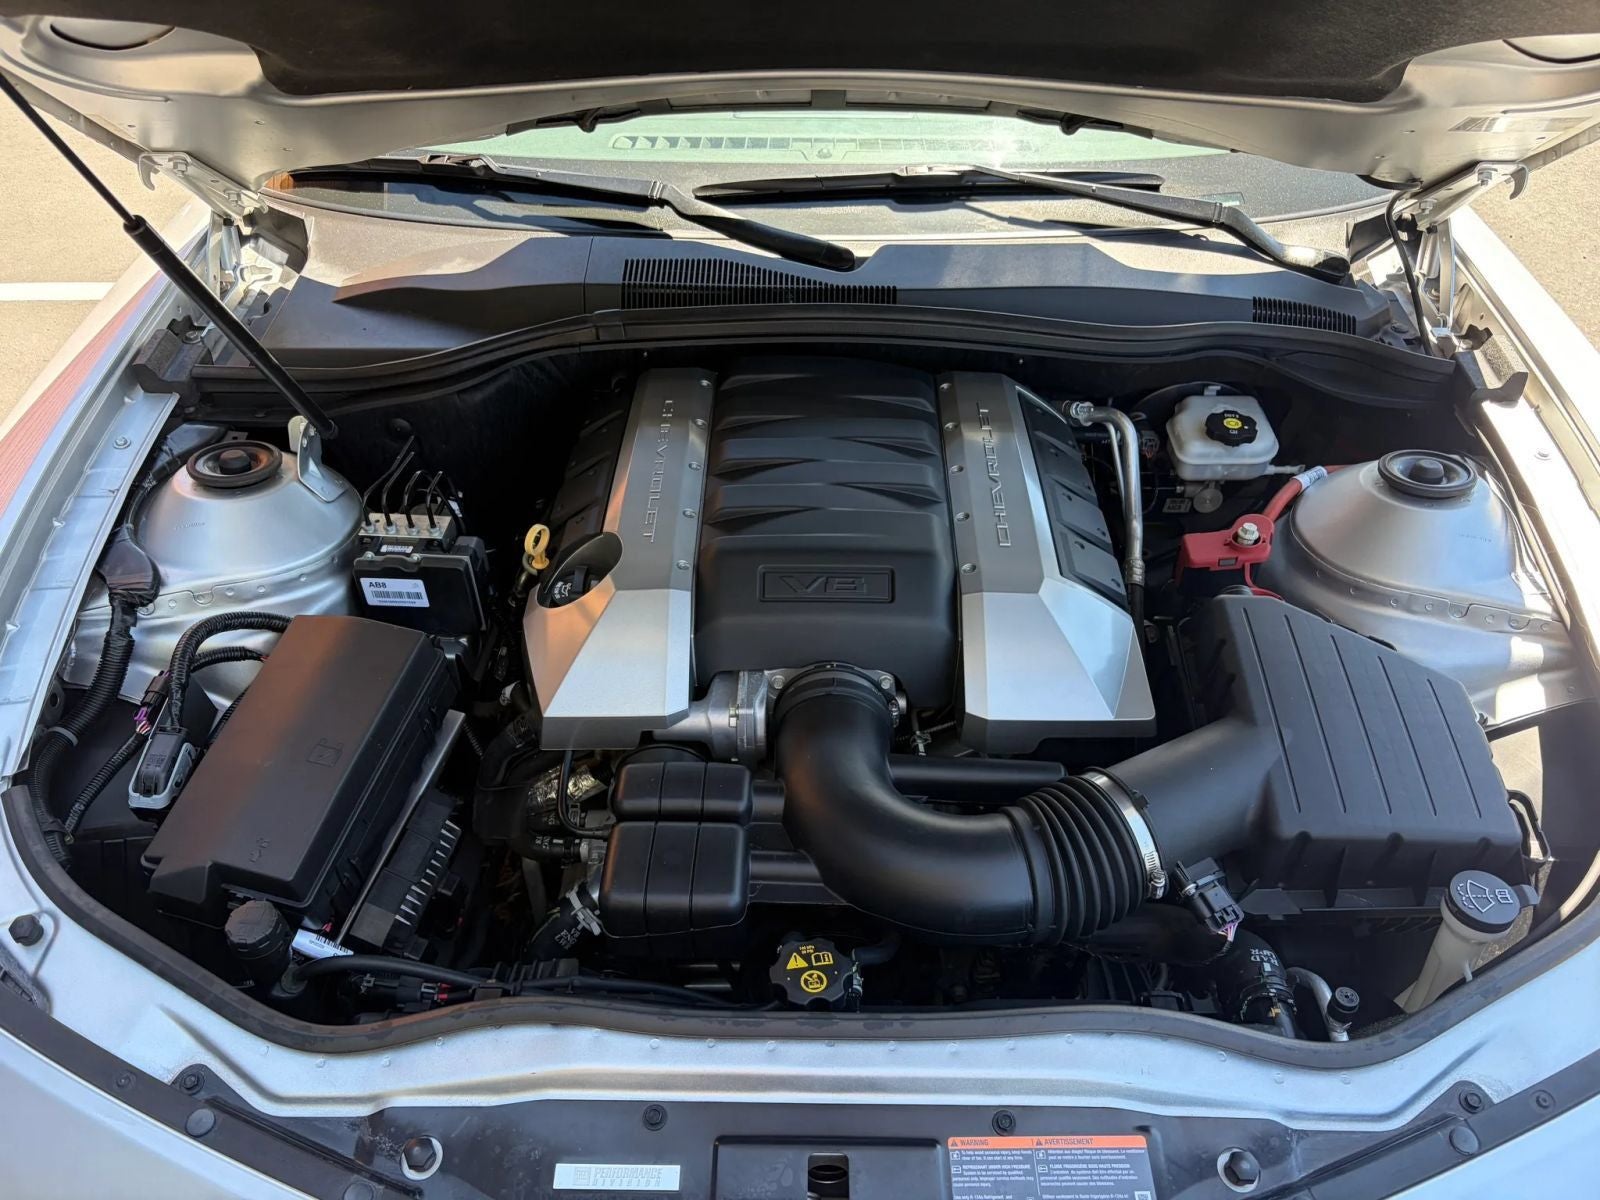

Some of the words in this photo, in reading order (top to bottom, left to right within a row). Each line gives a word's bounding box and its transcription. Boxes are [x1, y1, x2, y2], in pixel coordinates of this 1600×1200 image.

[643, 400, 674, 543] CHEVROLET
[976, 401, 1012, 547] CHEVROLET
[368, 581, 387, 589] AB8
[593, 1167, 663, 1179] PERFORMANCE
